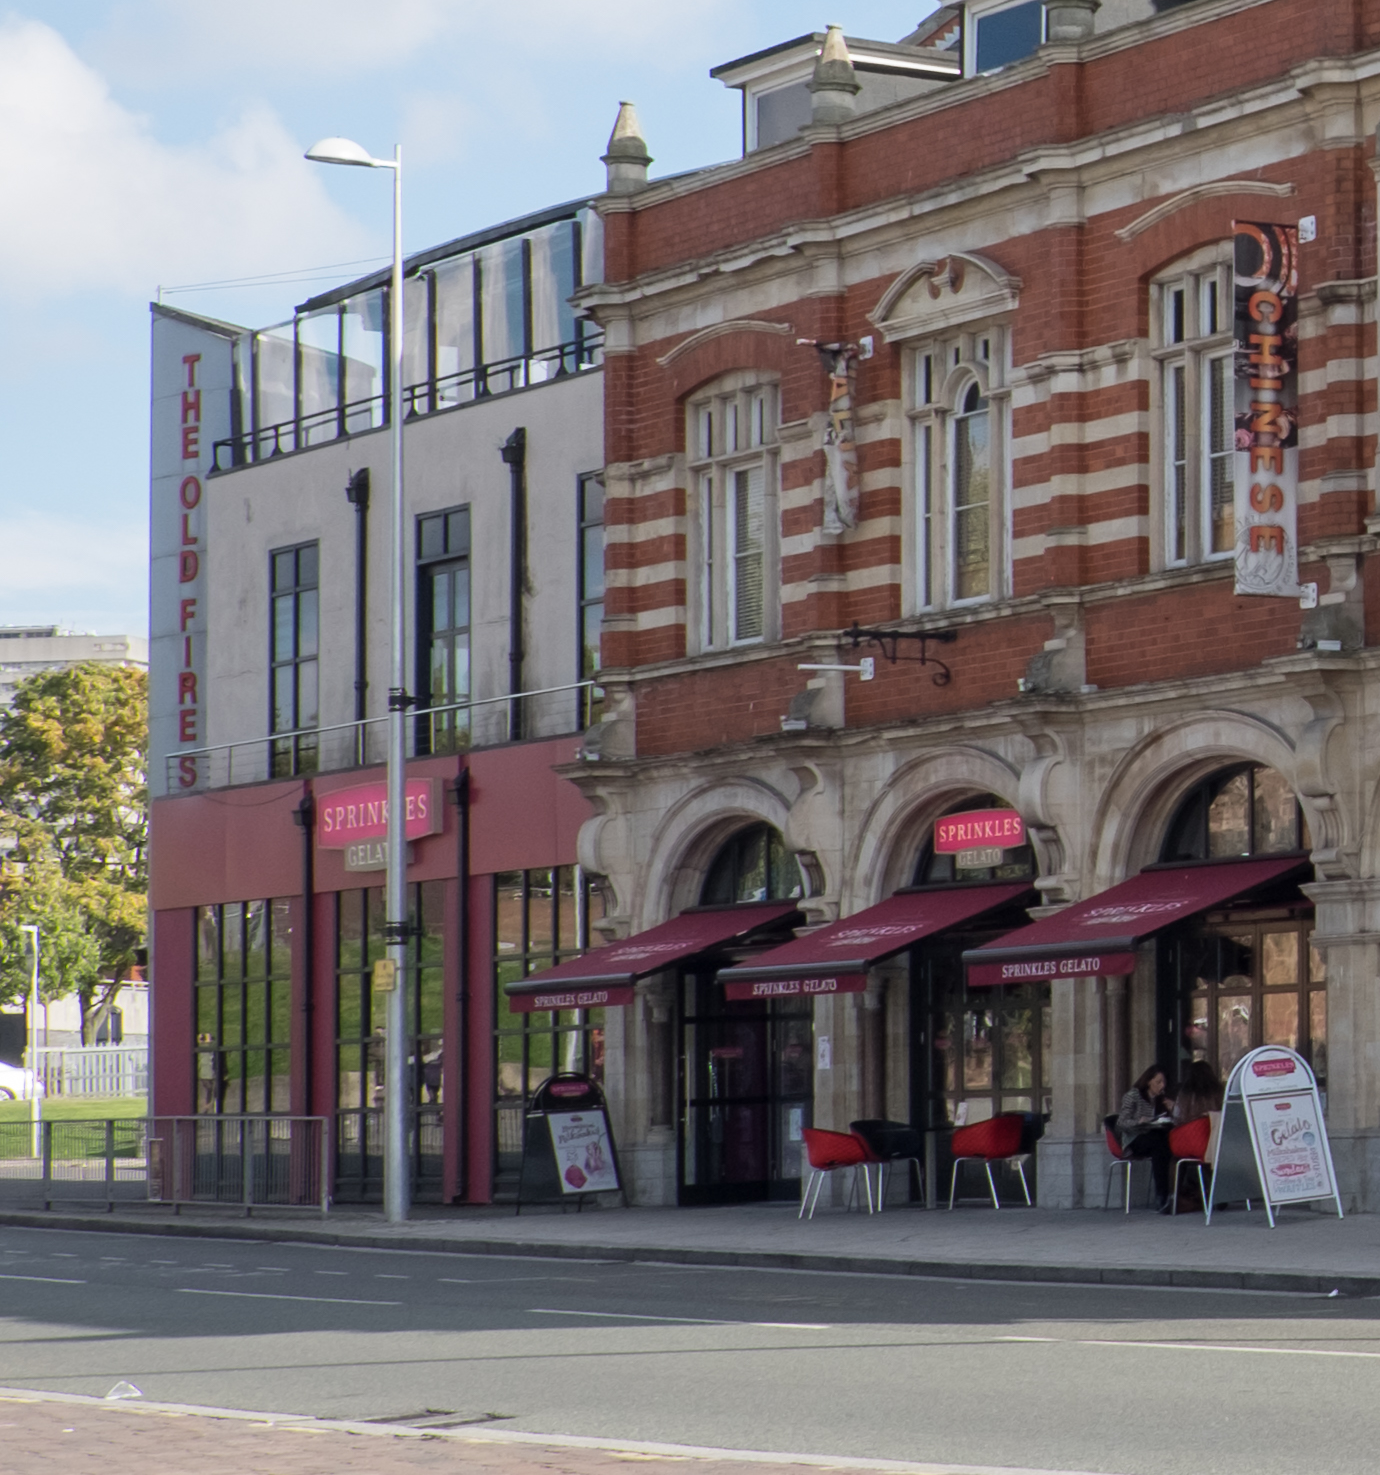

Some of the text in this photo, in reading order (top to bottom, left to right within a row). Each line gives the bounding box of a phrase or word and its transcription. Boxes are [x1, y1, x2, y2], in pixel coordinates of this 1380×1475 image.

[1248, 291, 1284, 555] CHINESE
[178, 354, 202, 788] THE OLD FIRES
[324, 793, 428, 832] SPRINKES
[939, 817, 1021, 843] SPRINKLES
[960, 848, 1001, 866] GELATO
[1002, 957, 1100, 978] SPRINKLES GELATO
[752, 978, 837, 995] SPRINKLES GELATO
[534, 991, 608, 1007] SPRINKLES GELATO
